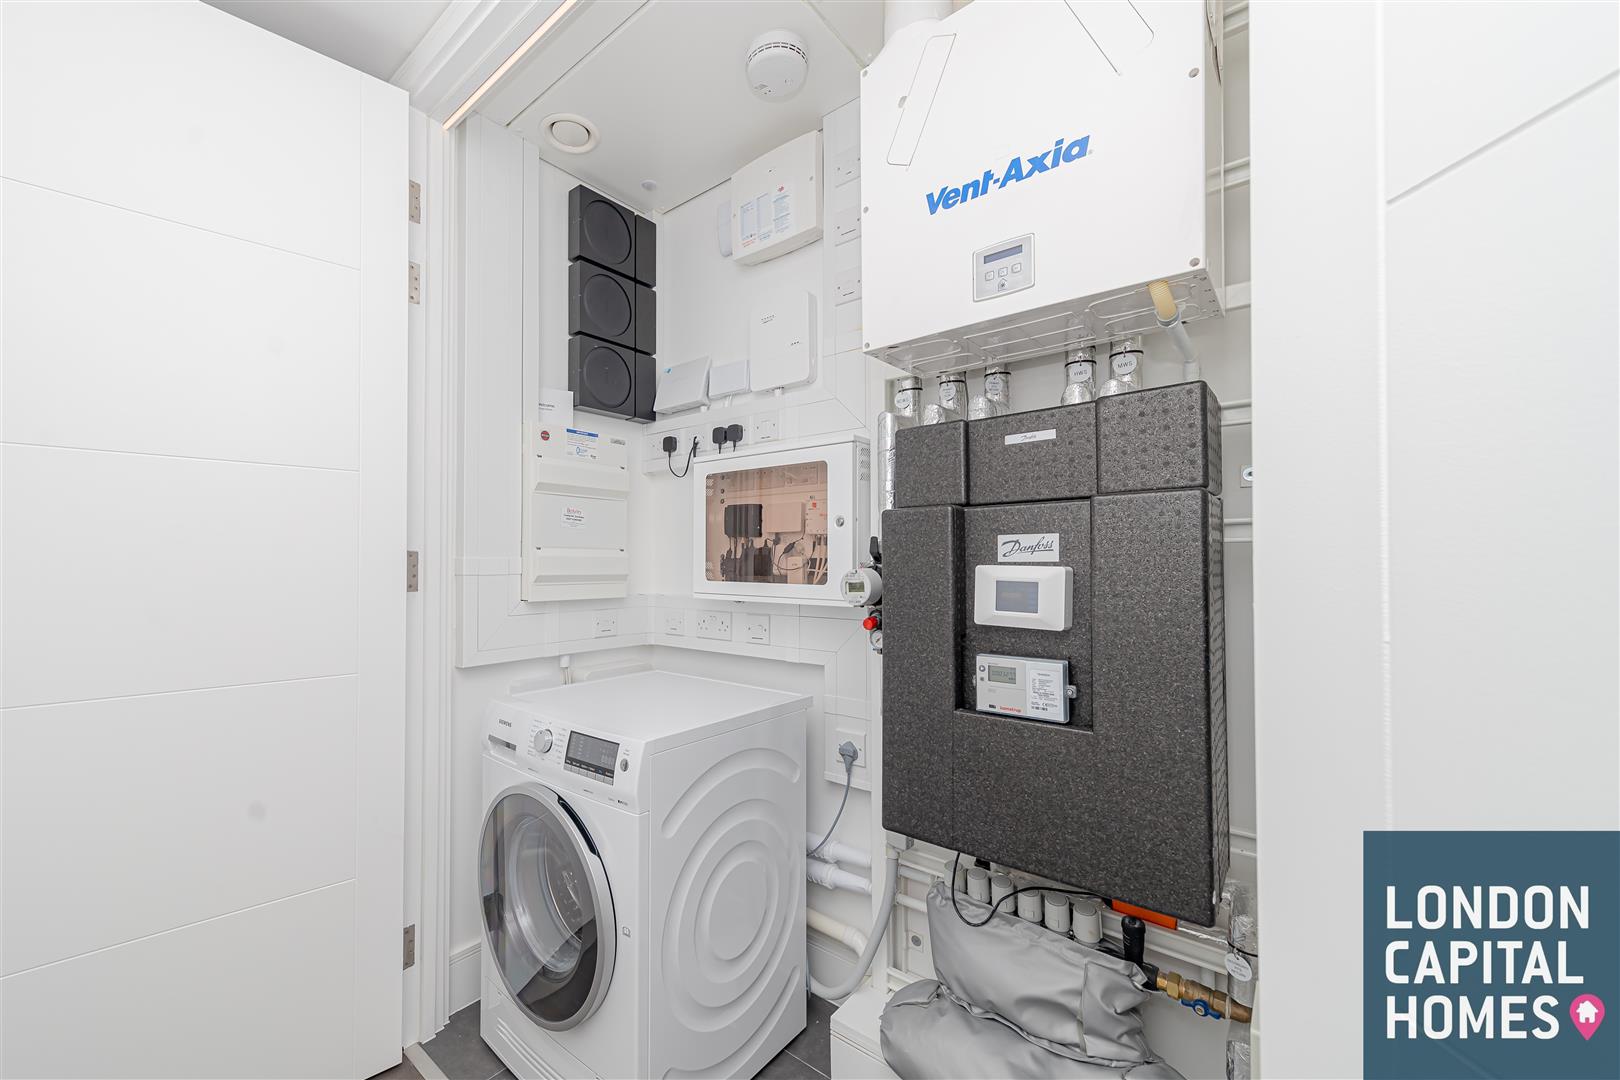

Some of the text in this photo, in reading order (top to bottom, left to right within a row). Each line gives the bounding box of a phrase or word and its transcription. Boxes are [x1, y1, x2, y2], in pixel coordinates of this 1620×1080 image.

[926, 135, 1090, 216] Vent-Axia
[1117, 360, 1133, 369] MWS
[1001, 535, 1055, 558] Danfoss
